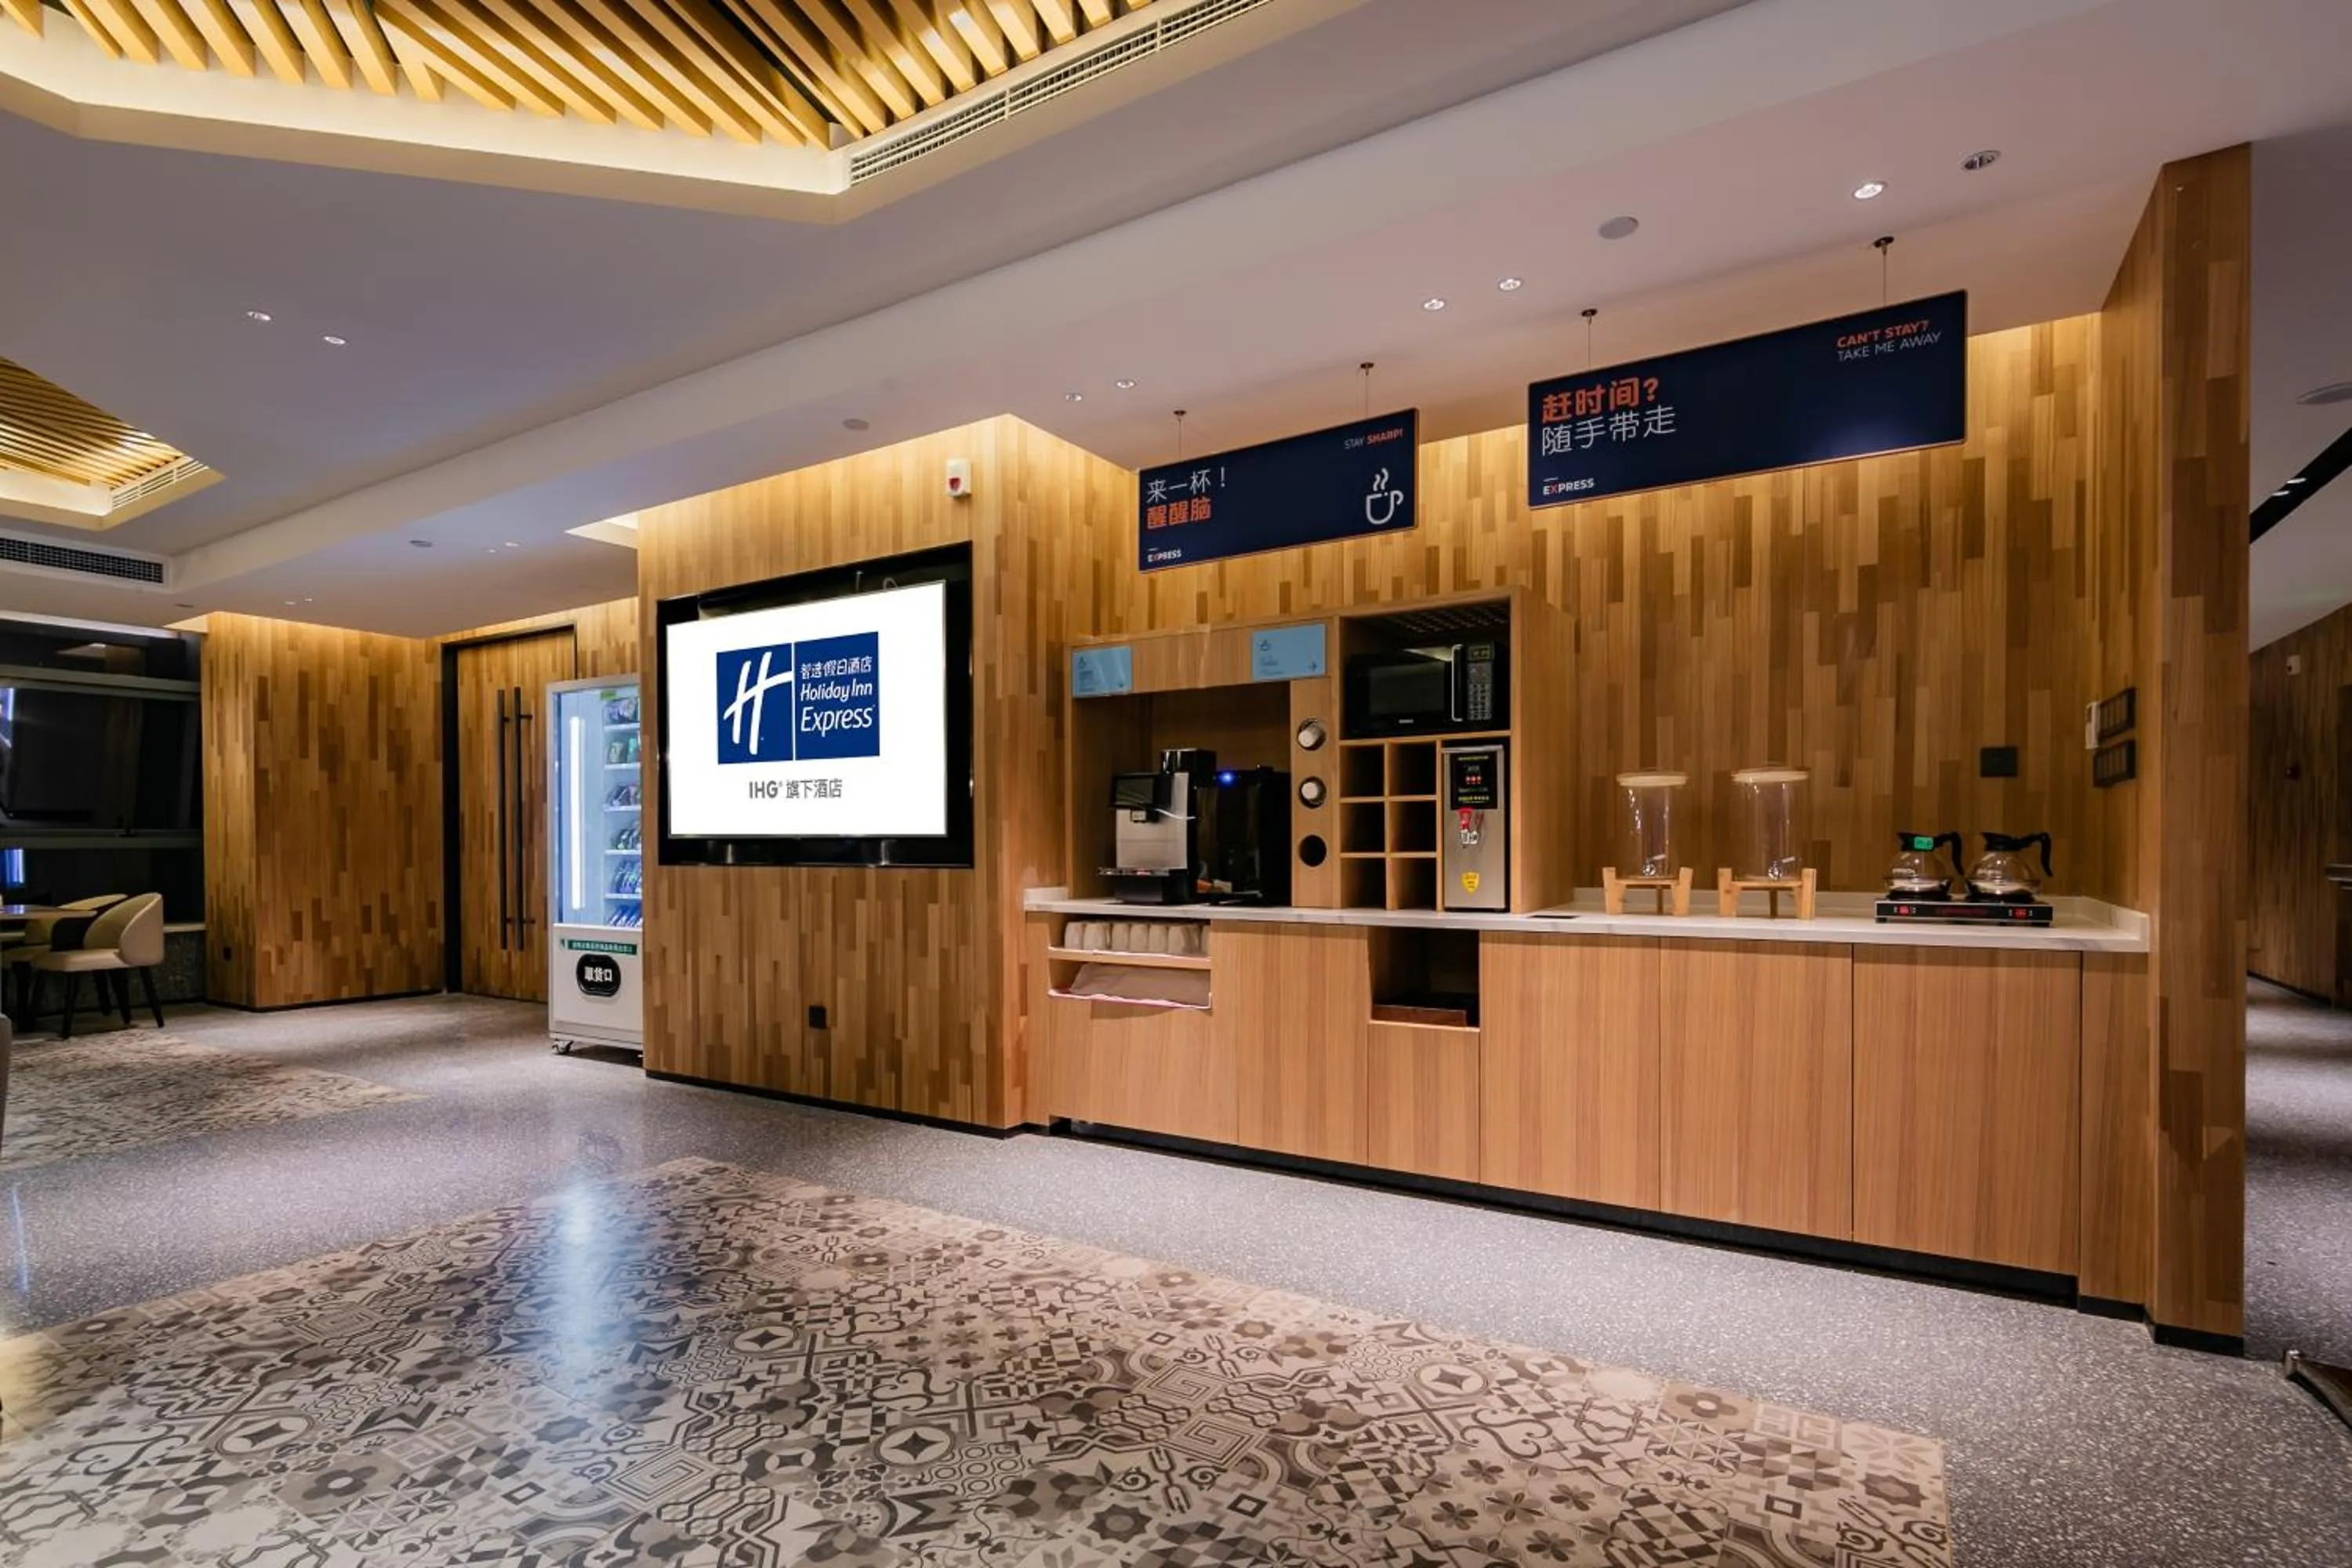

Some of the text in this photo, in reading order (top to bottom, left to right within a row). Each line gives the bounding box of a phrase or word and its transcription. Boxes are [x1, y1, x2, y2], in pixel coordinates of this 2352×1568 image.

[1836, 320, 1929, 348] CAN'T STAY?
[1838, 330, 1942, 362] TAKE ME AWAY
[1542, 377, 1659, 424] 赶时间?
[1344, 436, 1364, 449] STAY
[1541, 404, 1677, 456] 随手带走
[1542, 477, 1595, 495] EXPRESS
[1146, 497, 1211, 529] 醒醒脑
[800, 677, 873, 703] Holiday Inn
[800, 706, 873, 738] Express
[786, 778, 843, 799] 旗下酒店
